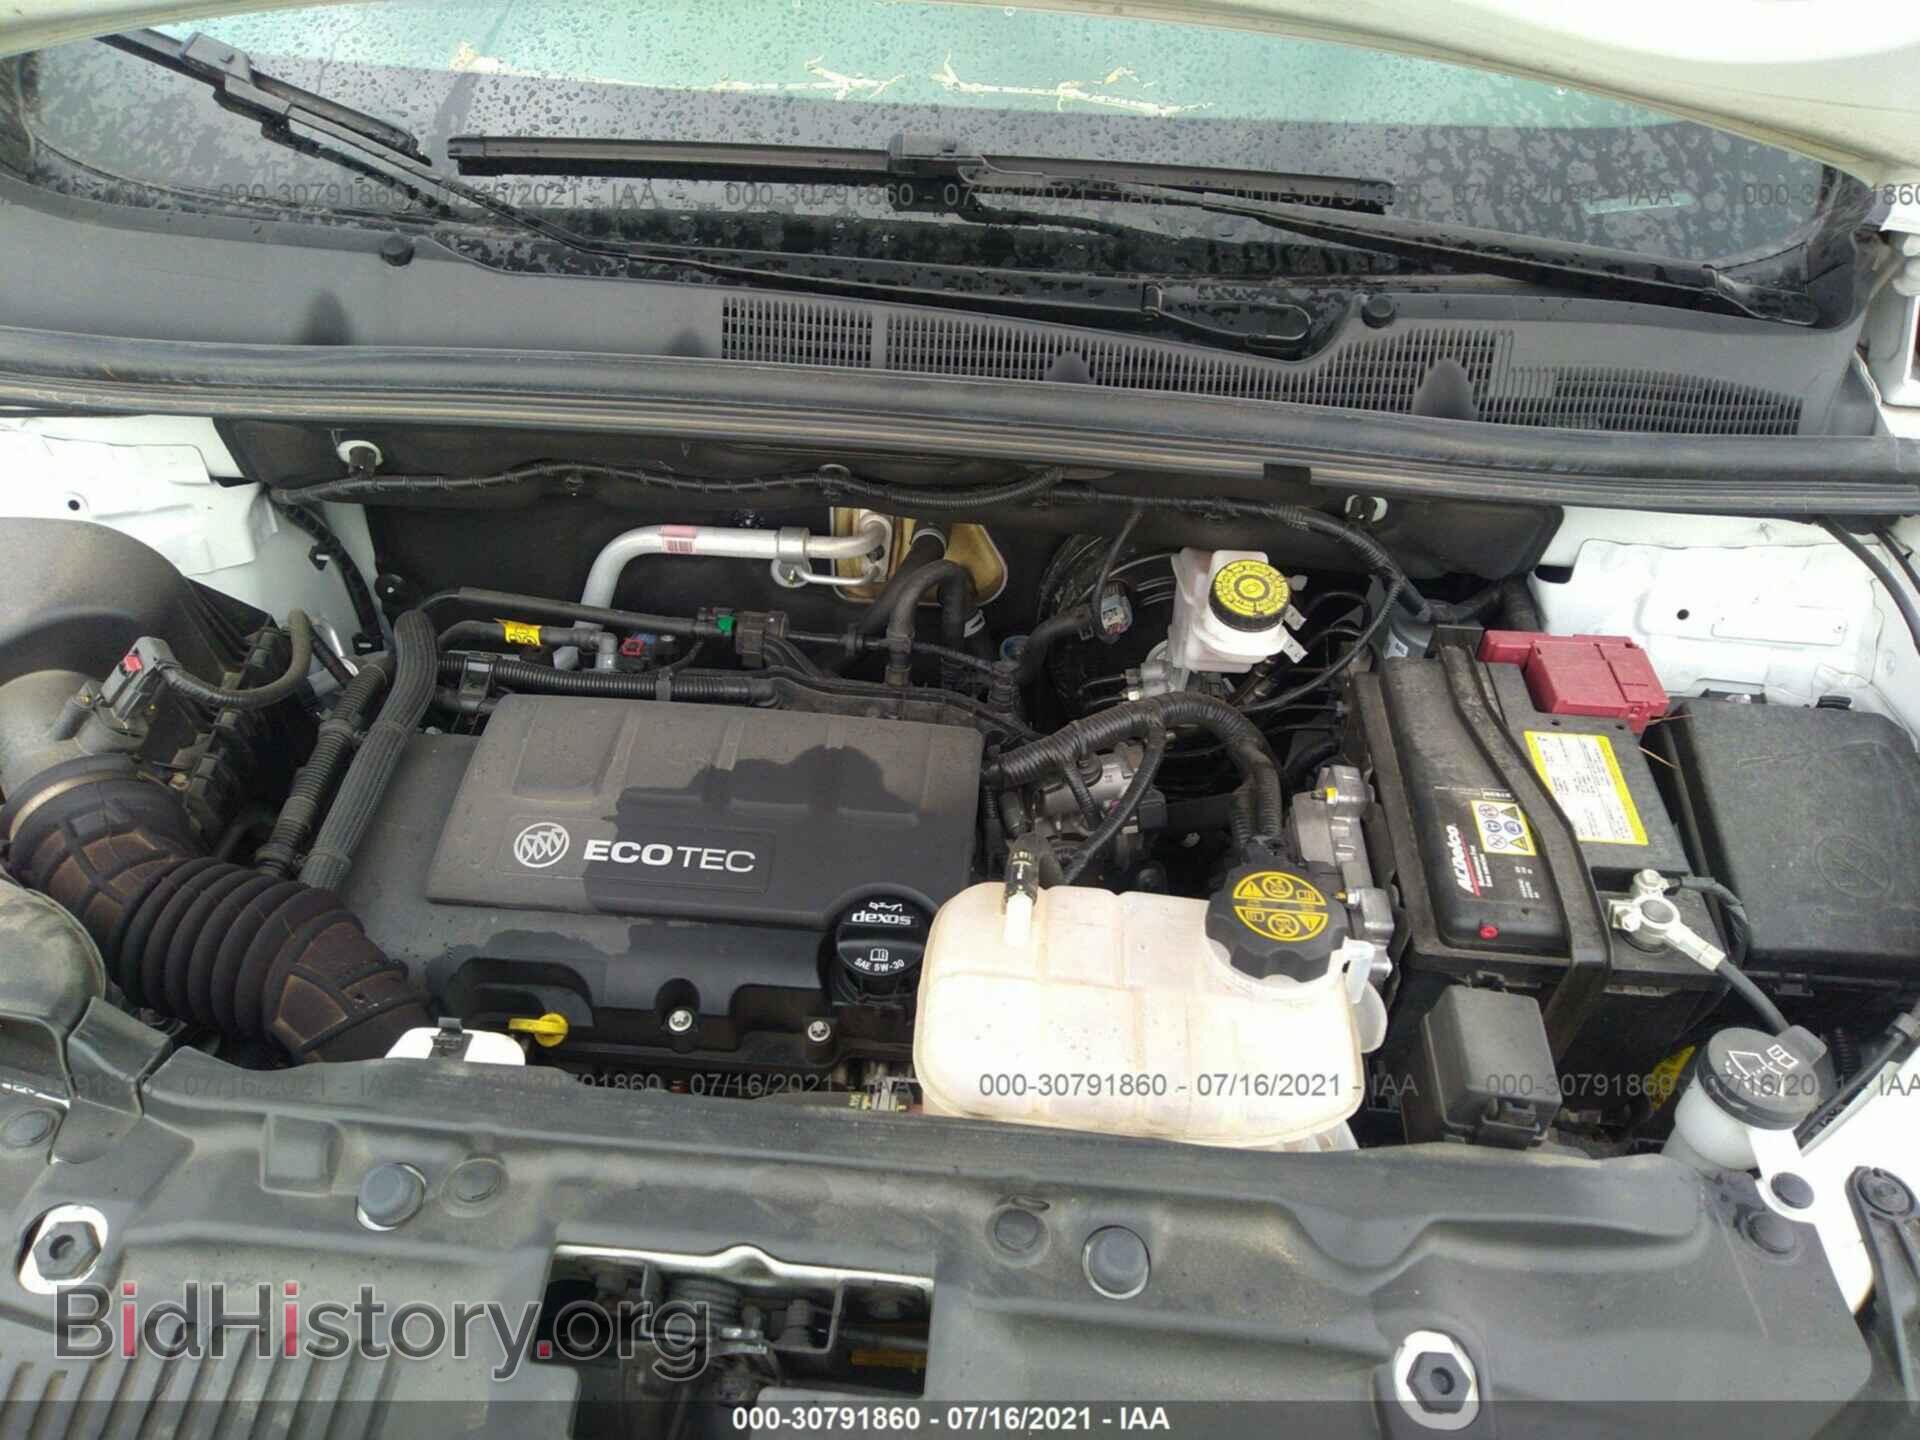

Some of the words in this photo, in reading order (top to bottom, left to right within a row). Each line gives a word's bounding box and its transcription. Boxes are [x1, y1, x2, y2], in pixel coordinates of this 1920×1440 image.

[584, 839, 756, 873] ECOTEC
[851, 910, 912, 926] dexos
[854, 957, 871, 970] SAE
[874, 959, 905, 972] 5W-30
